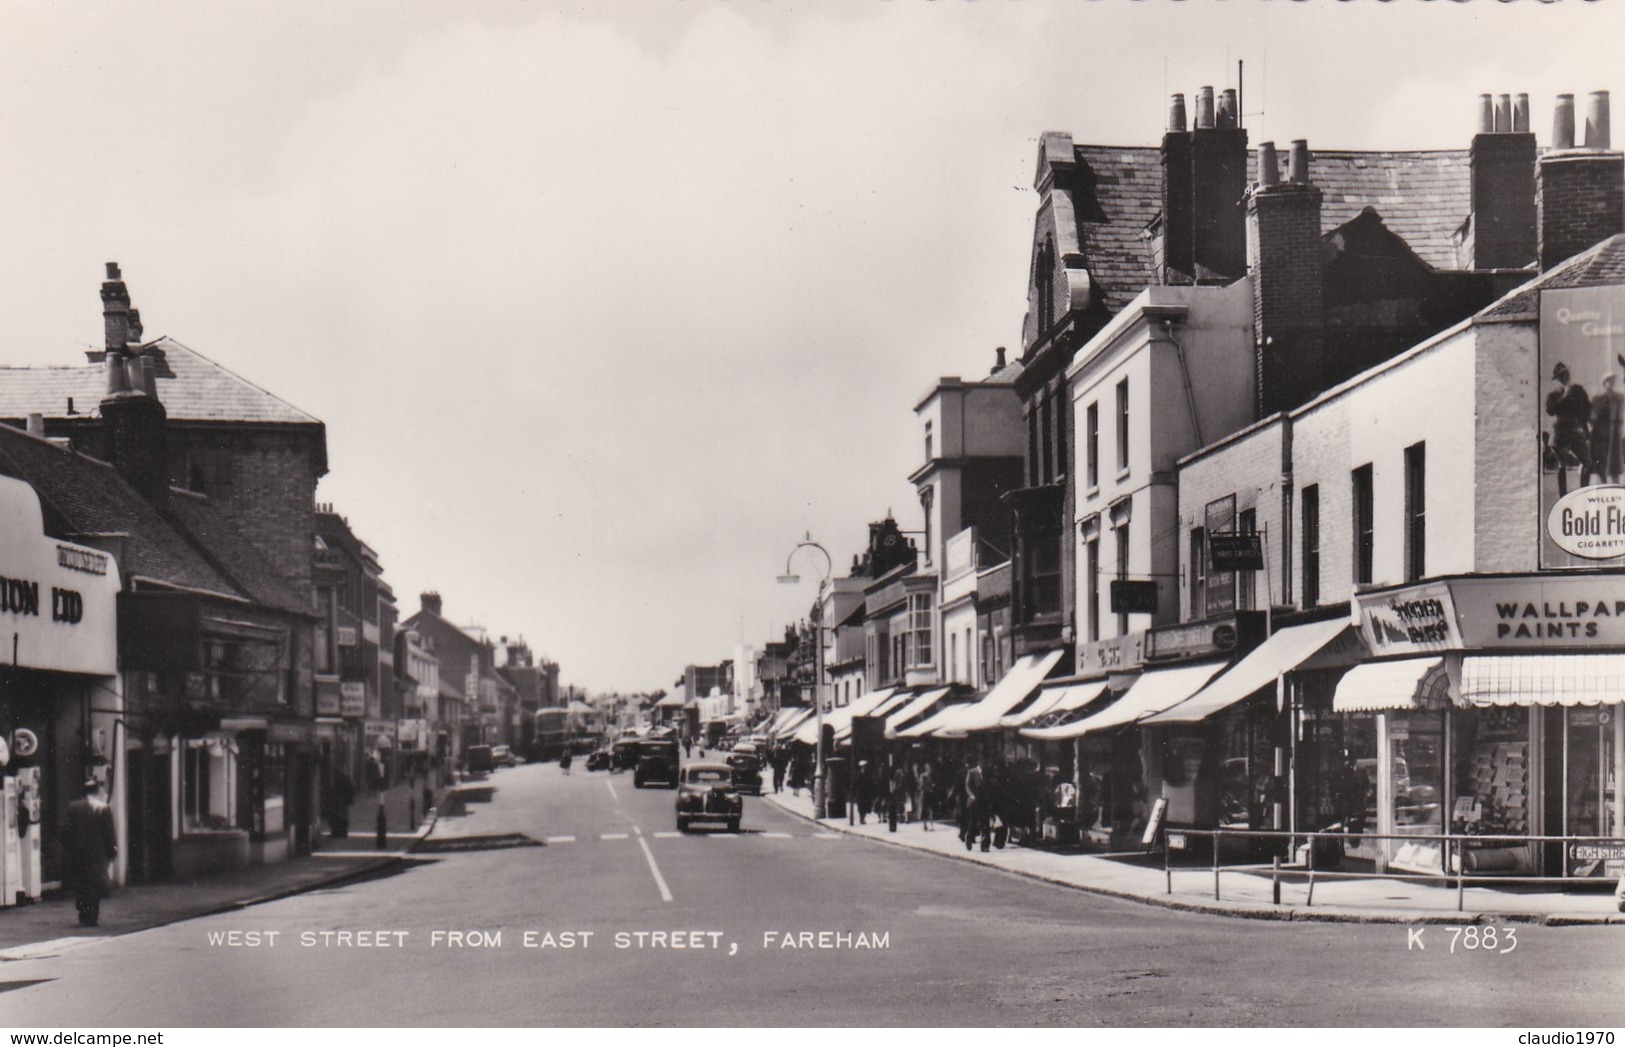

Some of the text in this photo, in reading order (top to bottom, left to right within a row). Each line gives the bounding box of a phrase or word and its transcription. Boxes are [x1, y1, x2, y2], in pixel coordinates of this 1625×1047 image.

[1562, 507, 1600, 537] Gold
[52, 587, 83, 625] LTD
[1496, 601, 1625, 619] WALLPAP
[1497, 621, 1598, 639] PAINTS
